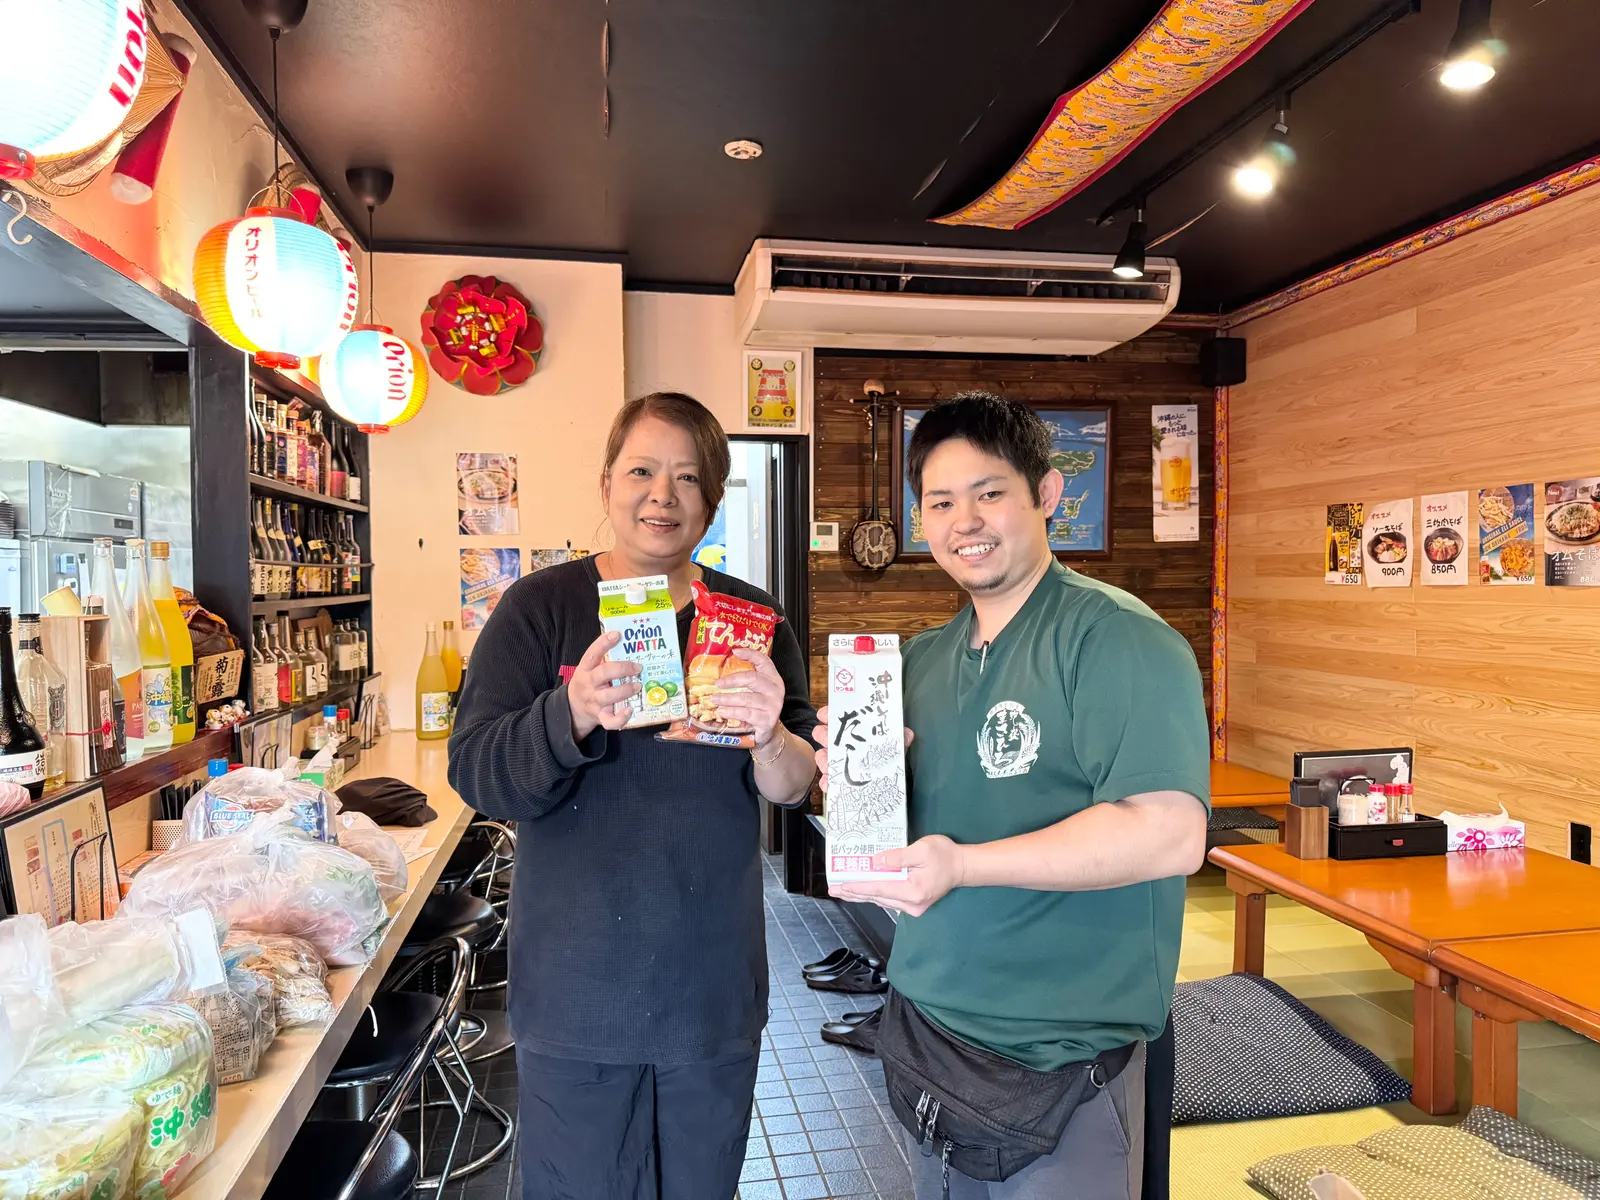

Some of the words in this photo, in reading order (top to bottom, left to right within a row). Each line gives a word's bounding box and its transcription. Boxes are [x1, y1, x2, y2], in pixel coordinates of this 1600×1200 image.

[244, 226, 265, 319] オリオンビール
[382, 341, 414, 402] Orion
[1426, 504, 1448, 513] オススメ
[1370, 511, 1391, 520] オススメ
[1551, 548, 1600, 562] オムそば
[1381, 567, 1405, 576] 900円
[1431, 563, 1457, 574] 850円
[624, 623, 663, 641] Orion
[623, 638, 667, 654] WATTA
[832, 638, 895, 647] さらにしい
[833, 705, 874, 786] だし
[213, 812, 232, 820] BLUE
[232, 812, 250, 820] SEAL
[830, 844, 875, 855] 紙パック使用
